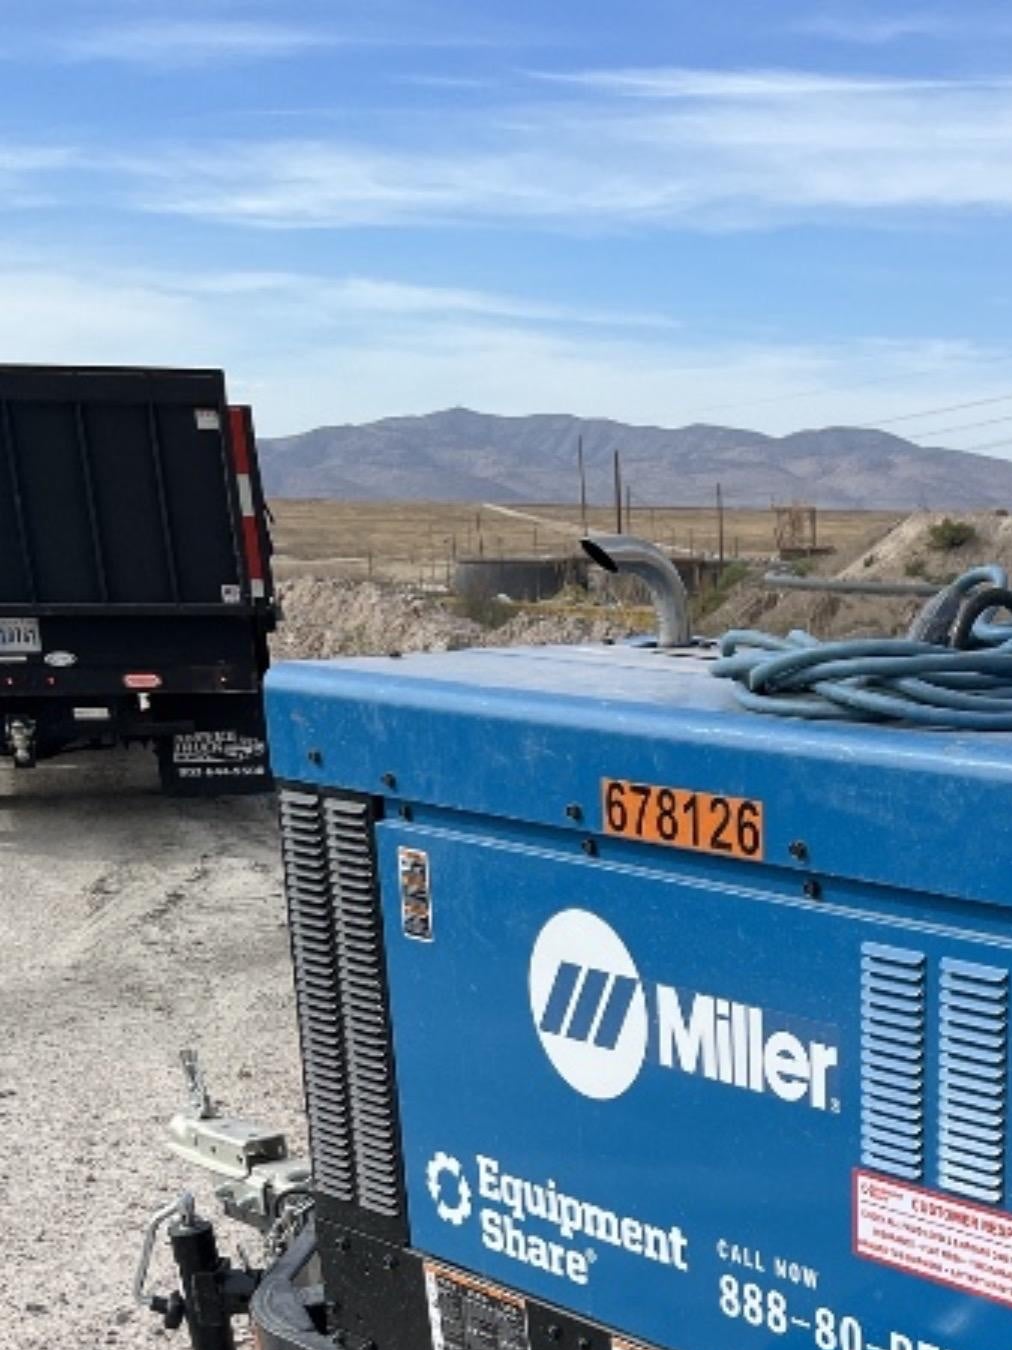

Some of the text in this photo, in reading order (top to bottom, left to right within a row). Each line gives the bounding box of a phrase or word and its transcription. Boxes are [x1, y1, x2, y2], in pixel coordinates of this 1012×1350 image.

[605, 782, 761, 856] 678126
[475, 1154, 688, 1272] Equipment
[911, 1200, 979, 1229] CUSTOMER
[716, 1238, 766, 1274] CALL
[772, 1256, 819, 1291] NOW
